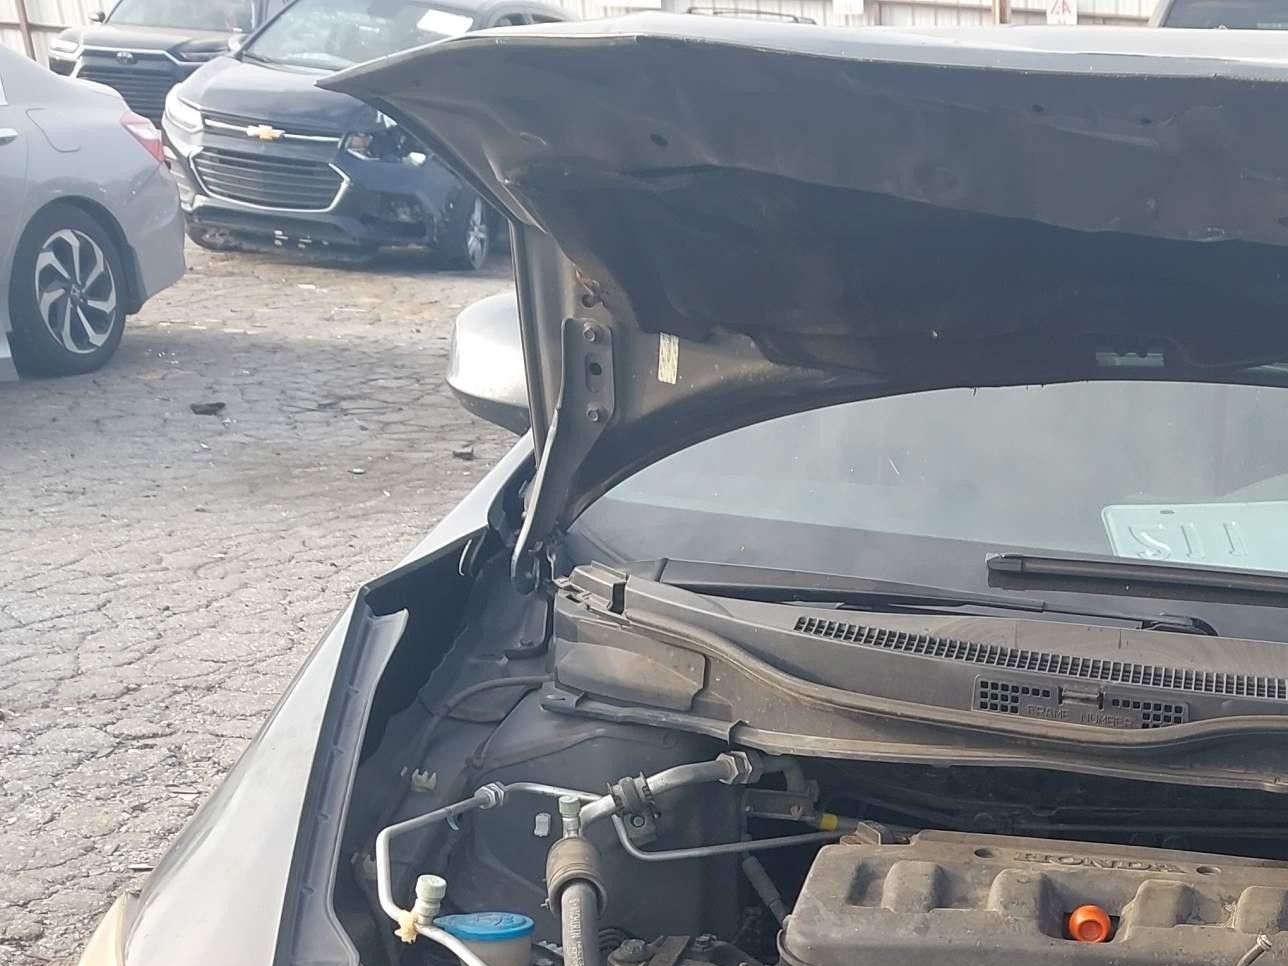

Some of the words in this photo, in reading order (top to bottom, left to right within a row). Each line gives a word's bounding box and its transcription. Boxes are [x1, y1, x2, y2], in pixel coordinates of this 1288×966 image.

[1027, 704, 1070, 720] FRAME
[1079, 711, 1138, 729] NUMBER
[1014, 852, 1186, 872] HONDA
